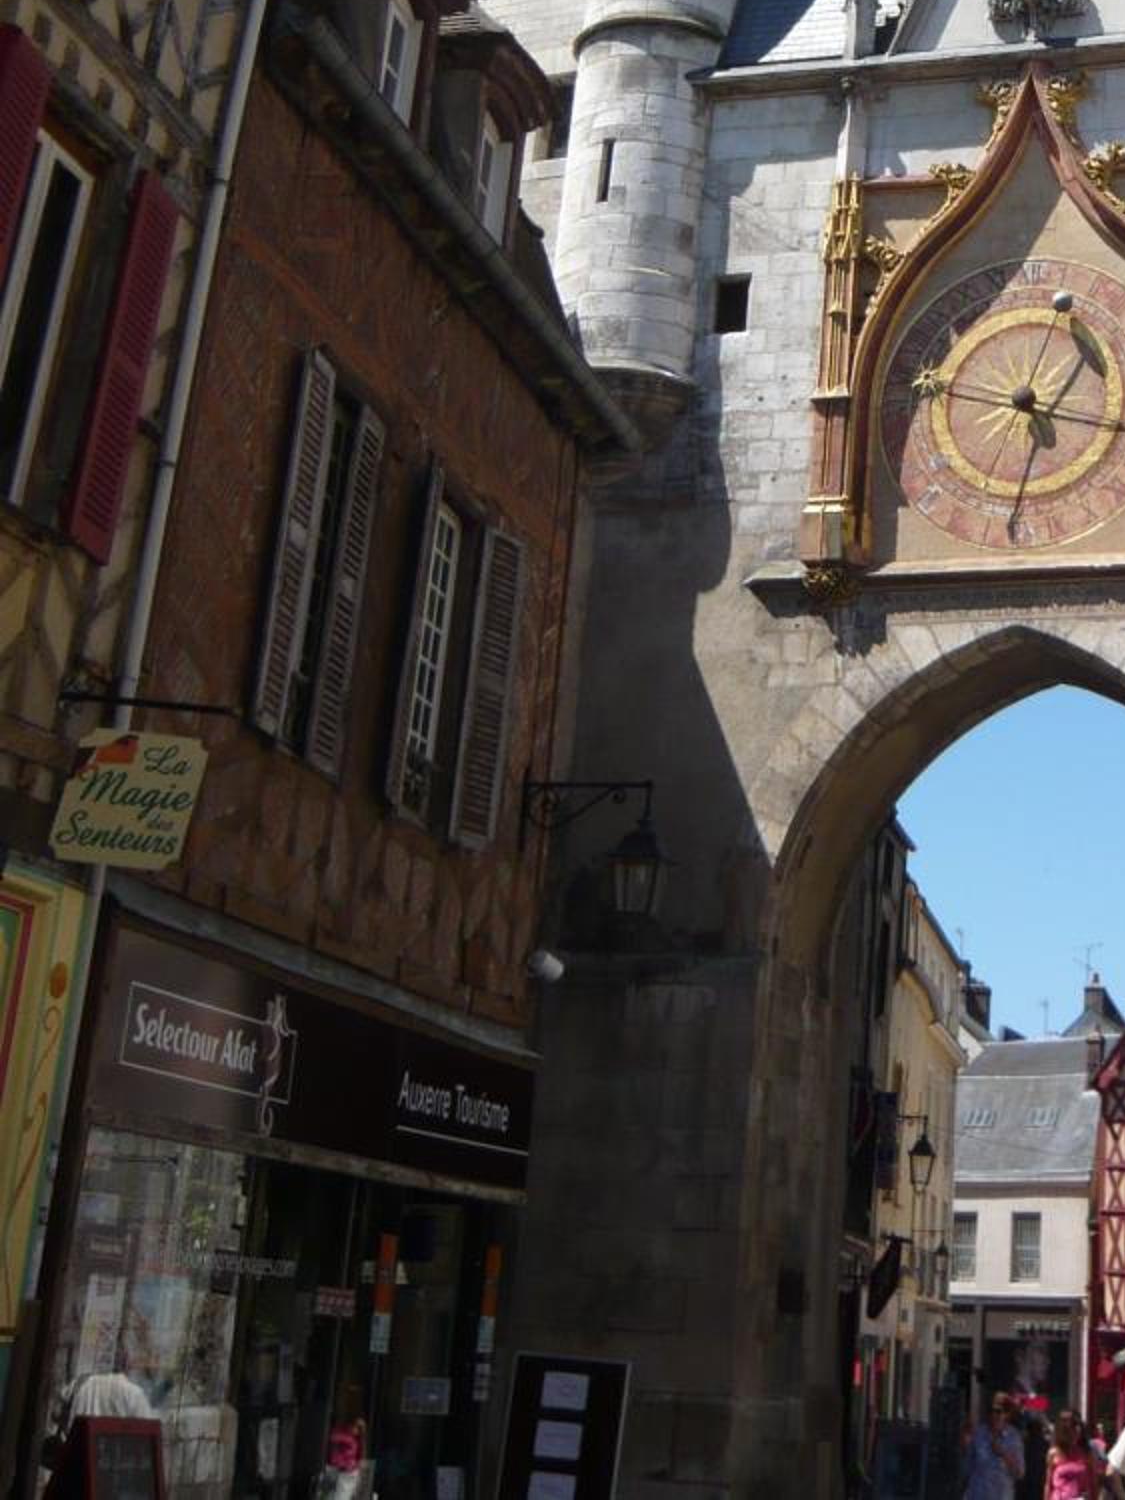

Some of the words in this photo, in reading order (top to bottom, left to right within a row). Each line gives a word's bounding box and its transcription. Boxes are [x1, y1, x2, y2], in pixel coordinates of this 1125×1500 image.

[143, 745, 195, 776] La
[79, 768, 193, 821] Magie
[55, 809, 178, 855] Senteurs
[132, 1002, 219, 1062] Selectour
[219, 1028, 258, 1075] Afat
[397, 1070, 451, 1120] Auxerre
[455, 1084, 510, 1132] Tourisme
